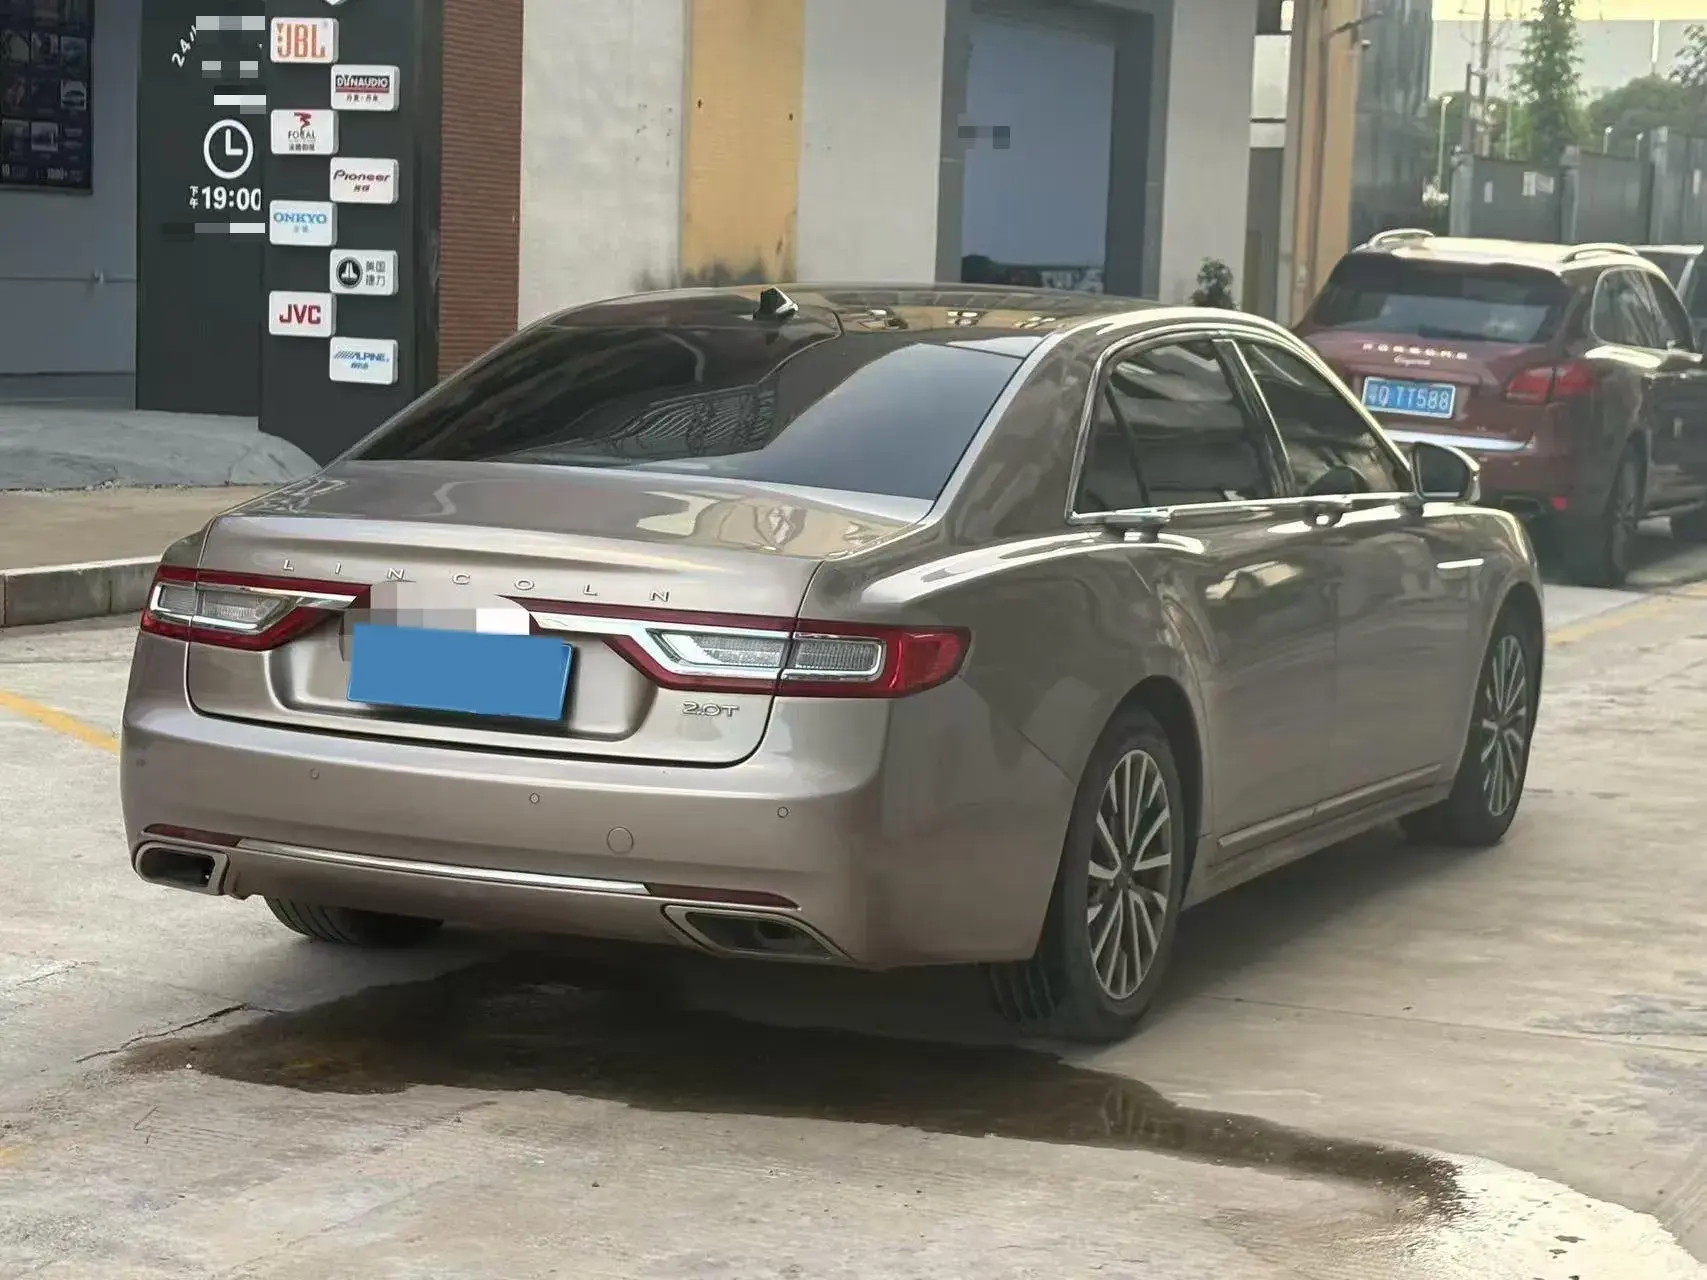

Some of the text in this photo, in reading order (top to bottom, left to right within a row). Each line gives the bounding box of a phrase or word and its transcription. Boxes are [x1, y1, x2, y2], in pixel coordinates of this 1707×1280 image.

[275, 23, 326, 58] JBL
[337, 74, 388, 88] DYNAUDIO
[333, 169, 391, 182] Pioneer
[202, 186, 262, 211] 19:00
[273, 212, 327, 224] ONKYO
[279, 304, 322, 325] JVC
[282, 559, 671, 604] LINCOLN
[681, 701, 741, 717] 2.0T
